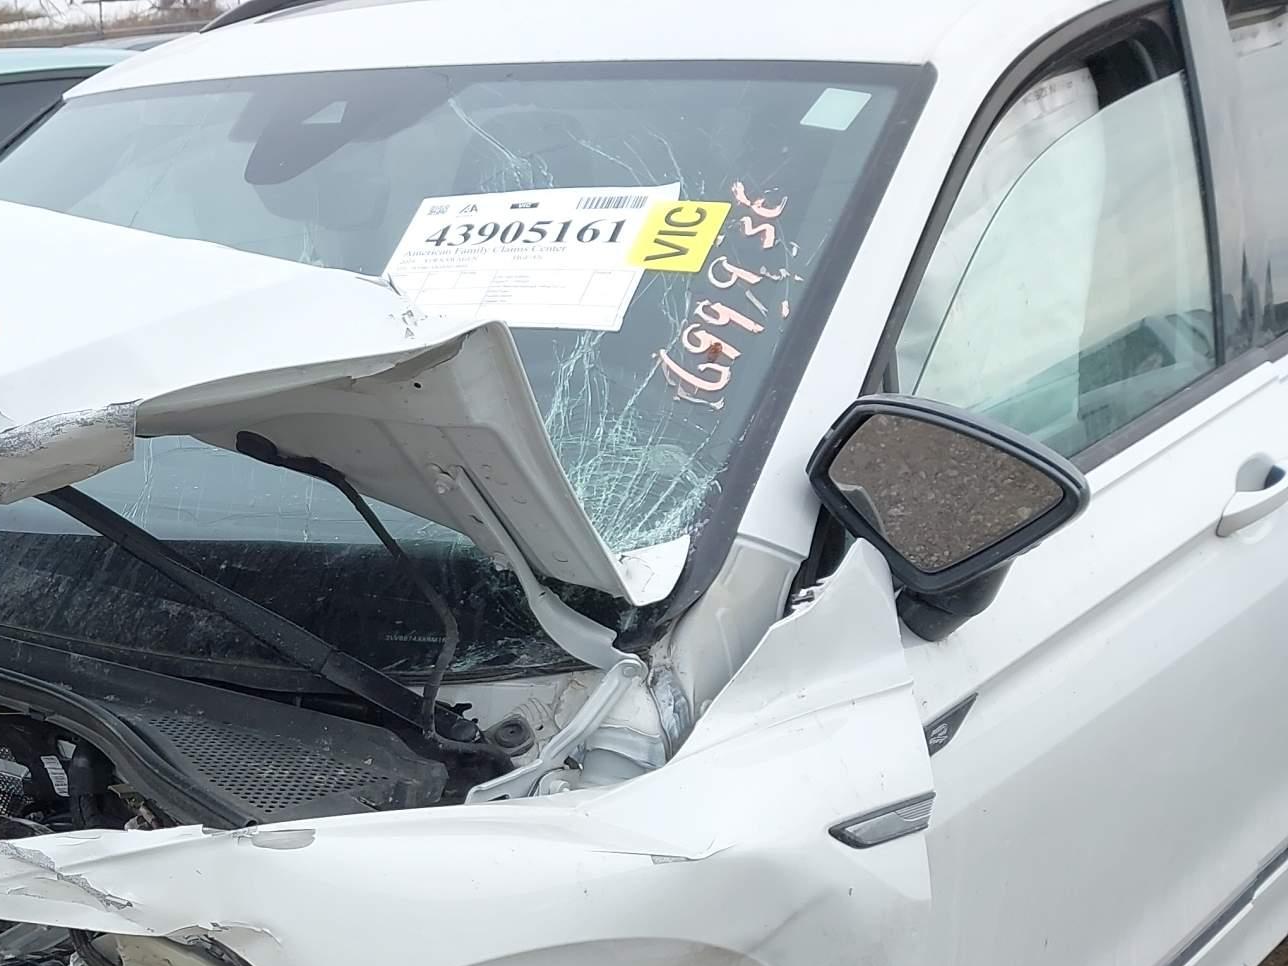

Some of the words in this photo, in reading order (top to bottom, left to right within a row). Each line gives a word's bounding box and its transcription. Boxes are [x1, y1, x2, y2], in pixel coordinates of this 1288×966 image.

[425, 218, 627, 246] 43905161
[643, 206, 708, 263] VIC
[454, 245, 487, 256] Family
[530, 243, 566, 253] Center
